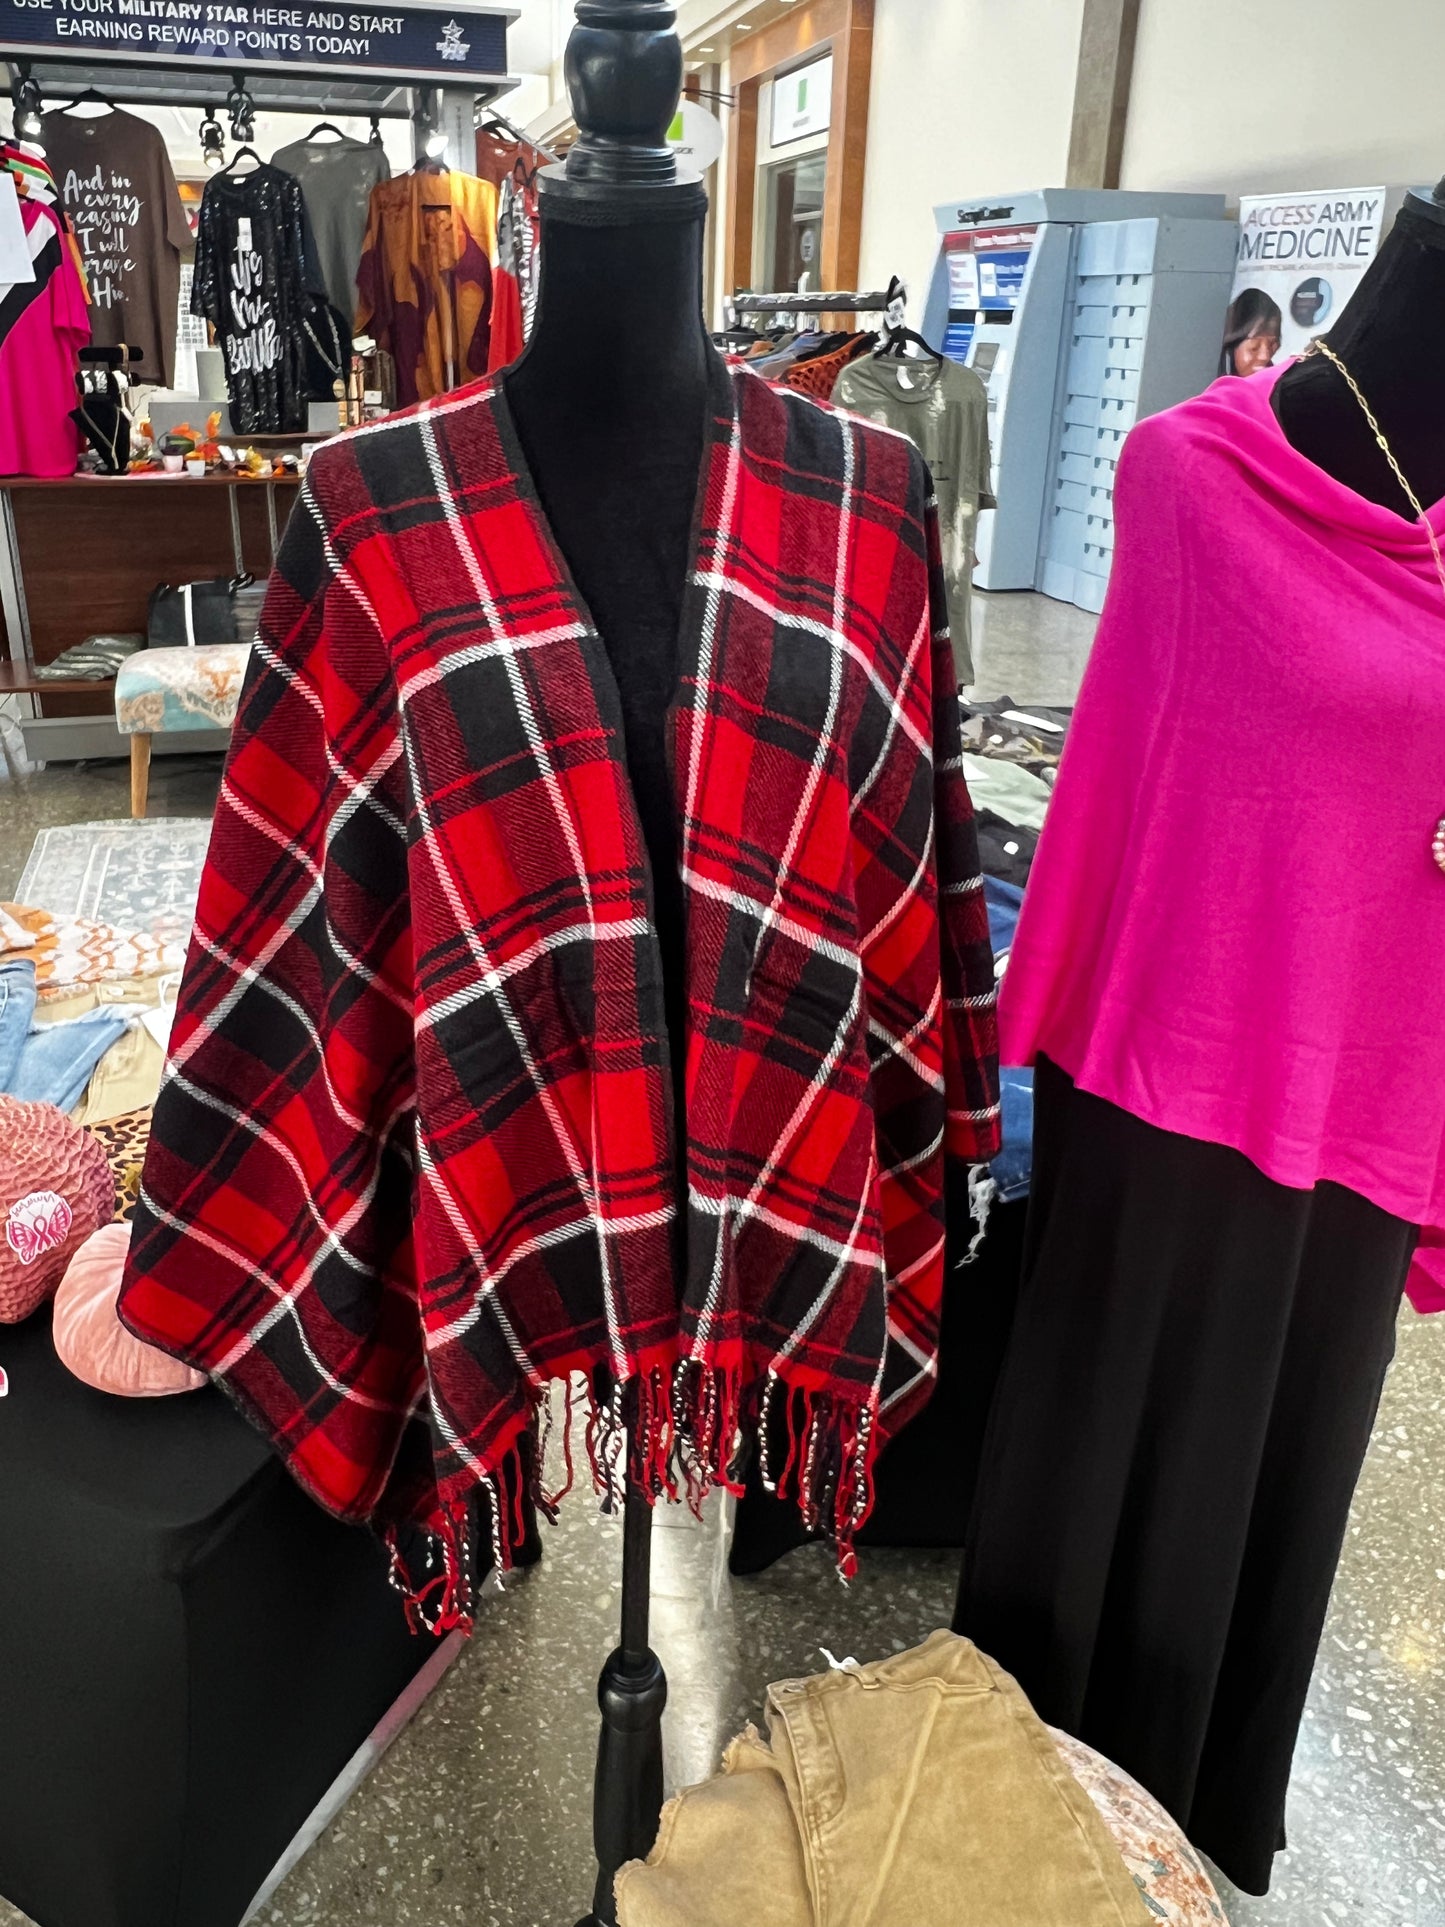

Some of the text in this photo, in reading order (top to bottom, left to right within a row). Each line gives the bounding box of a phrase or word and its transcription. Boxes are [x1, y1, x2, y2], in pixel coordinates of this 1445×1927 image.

[61, 0, 114, 14] YOUR
[119, 0, 202, 20] MILITARY
[206, 5, 249, 23] STAR
[253, 8, 304, 27] HERE
[306, 12, 345, 30] AND
[348, 15, 405, 34] START
[56, 18, 370, 56] EARNING REWARD POINTS TODAY!
[63, 164, 132, 205] And in
[84, 192, 145, 227] every
[1243, 199, 1379, 228] ACCESS ARMY
[77, 227, 96, 255] I
[1240, 226, 1374, 260] MEDICINE
